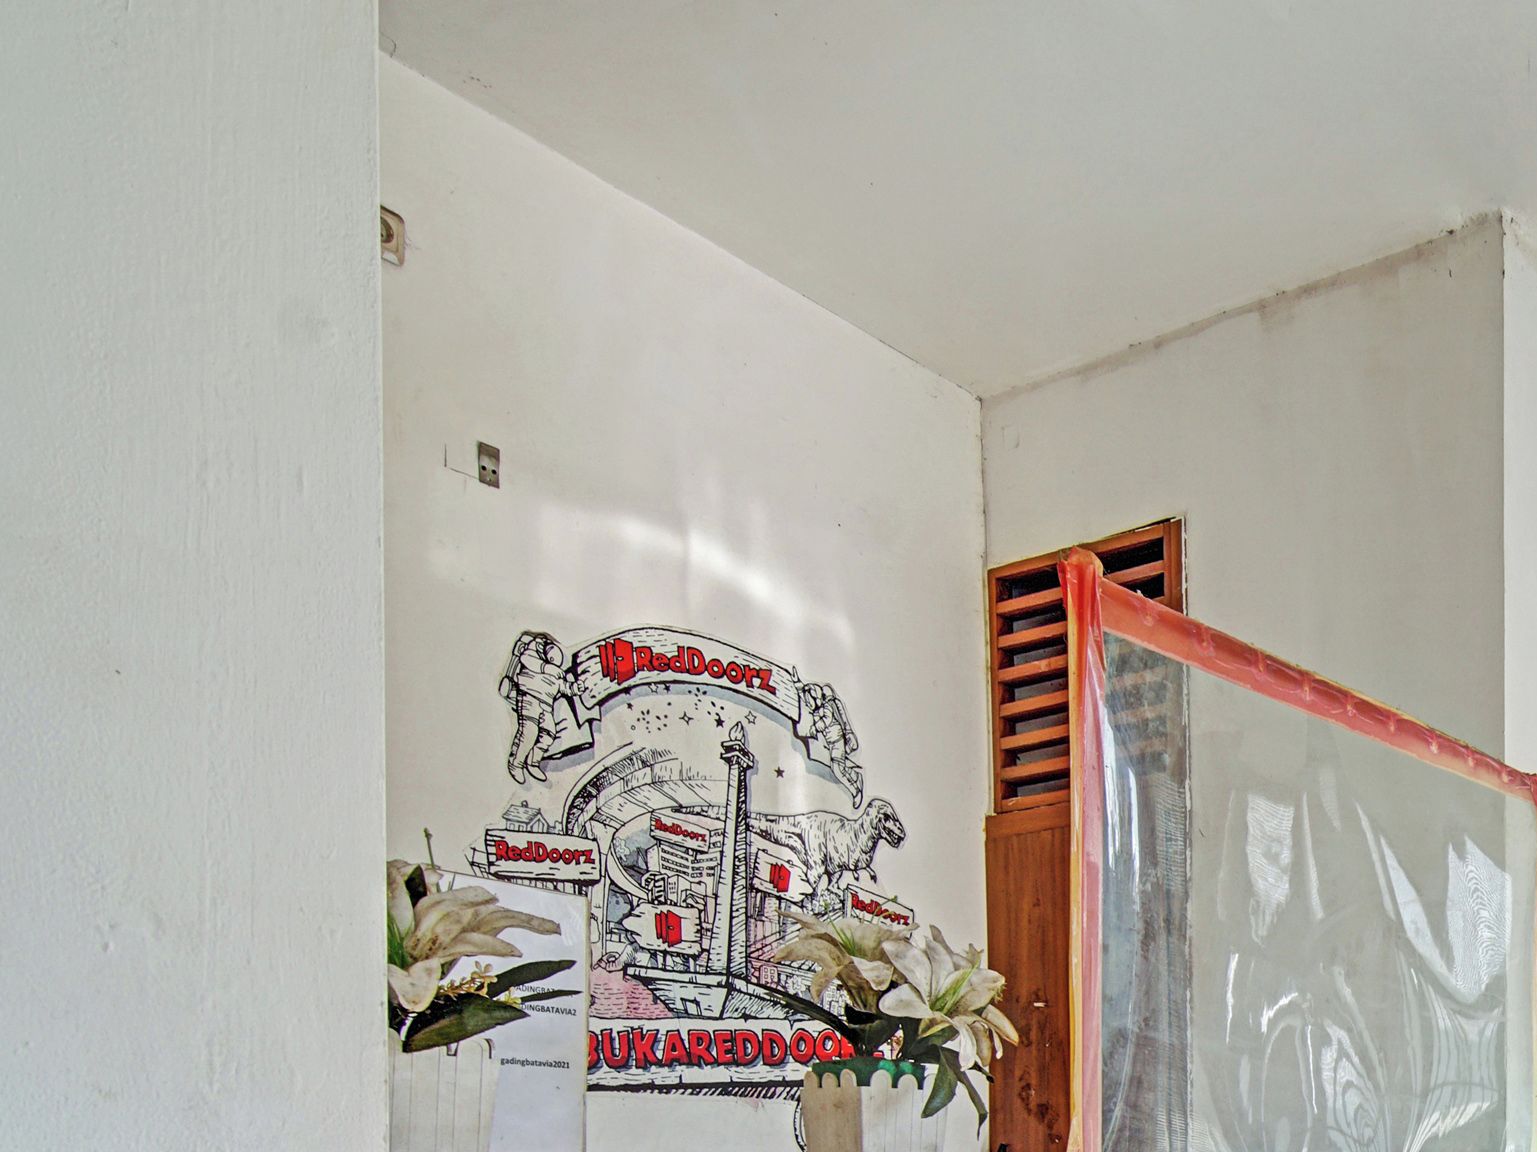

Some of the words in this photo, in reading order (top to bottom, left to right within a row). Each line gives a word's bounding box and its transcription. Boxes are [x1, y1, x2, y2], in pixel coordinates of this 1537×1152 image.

[635, 646, 777, 696] RedDoorz
[655, 818, 707, 843] RedDoorz
[494, 840, 596, 865] RedDoorz
[851, 892, 910, 926] RedDoorz
[500, 1057, 570, 1069] gadingbatavia2021
